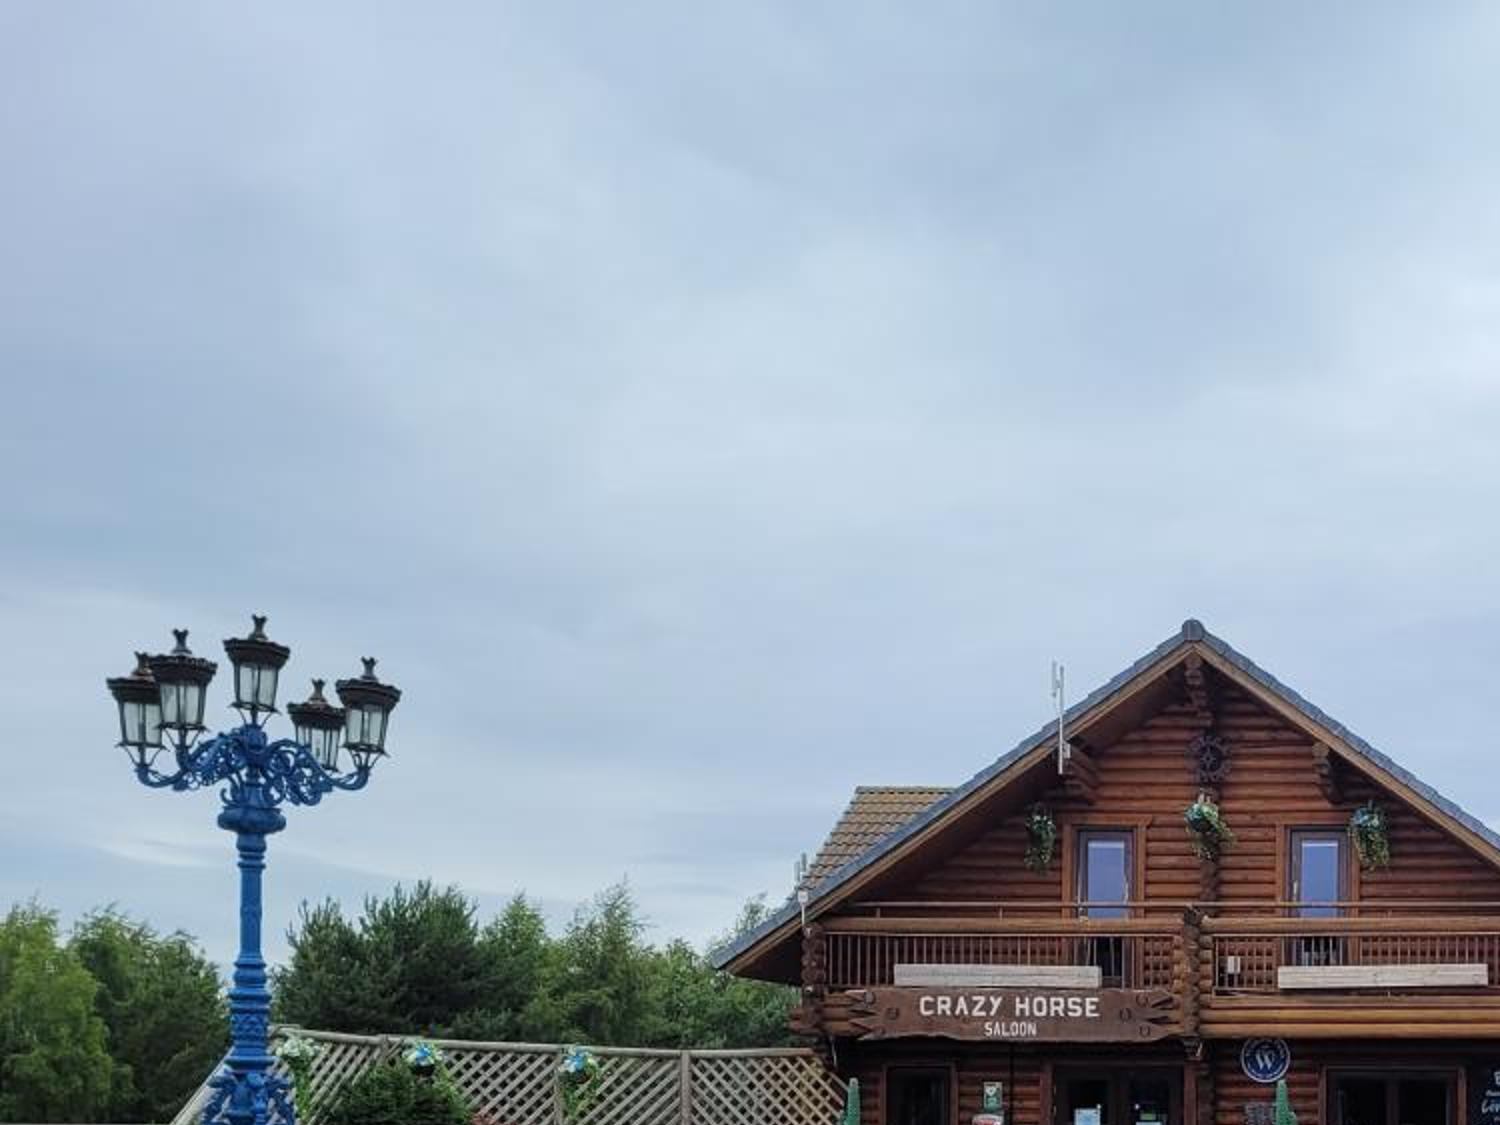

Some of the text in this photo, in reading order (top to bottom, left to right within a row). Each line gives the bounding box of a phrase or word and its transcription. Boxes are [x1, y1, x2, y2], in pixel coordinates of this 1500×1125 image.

[919, 995, 1100, 1018] CRAZY HORSE
[984, 1020, 1037, 1037] SALOON
